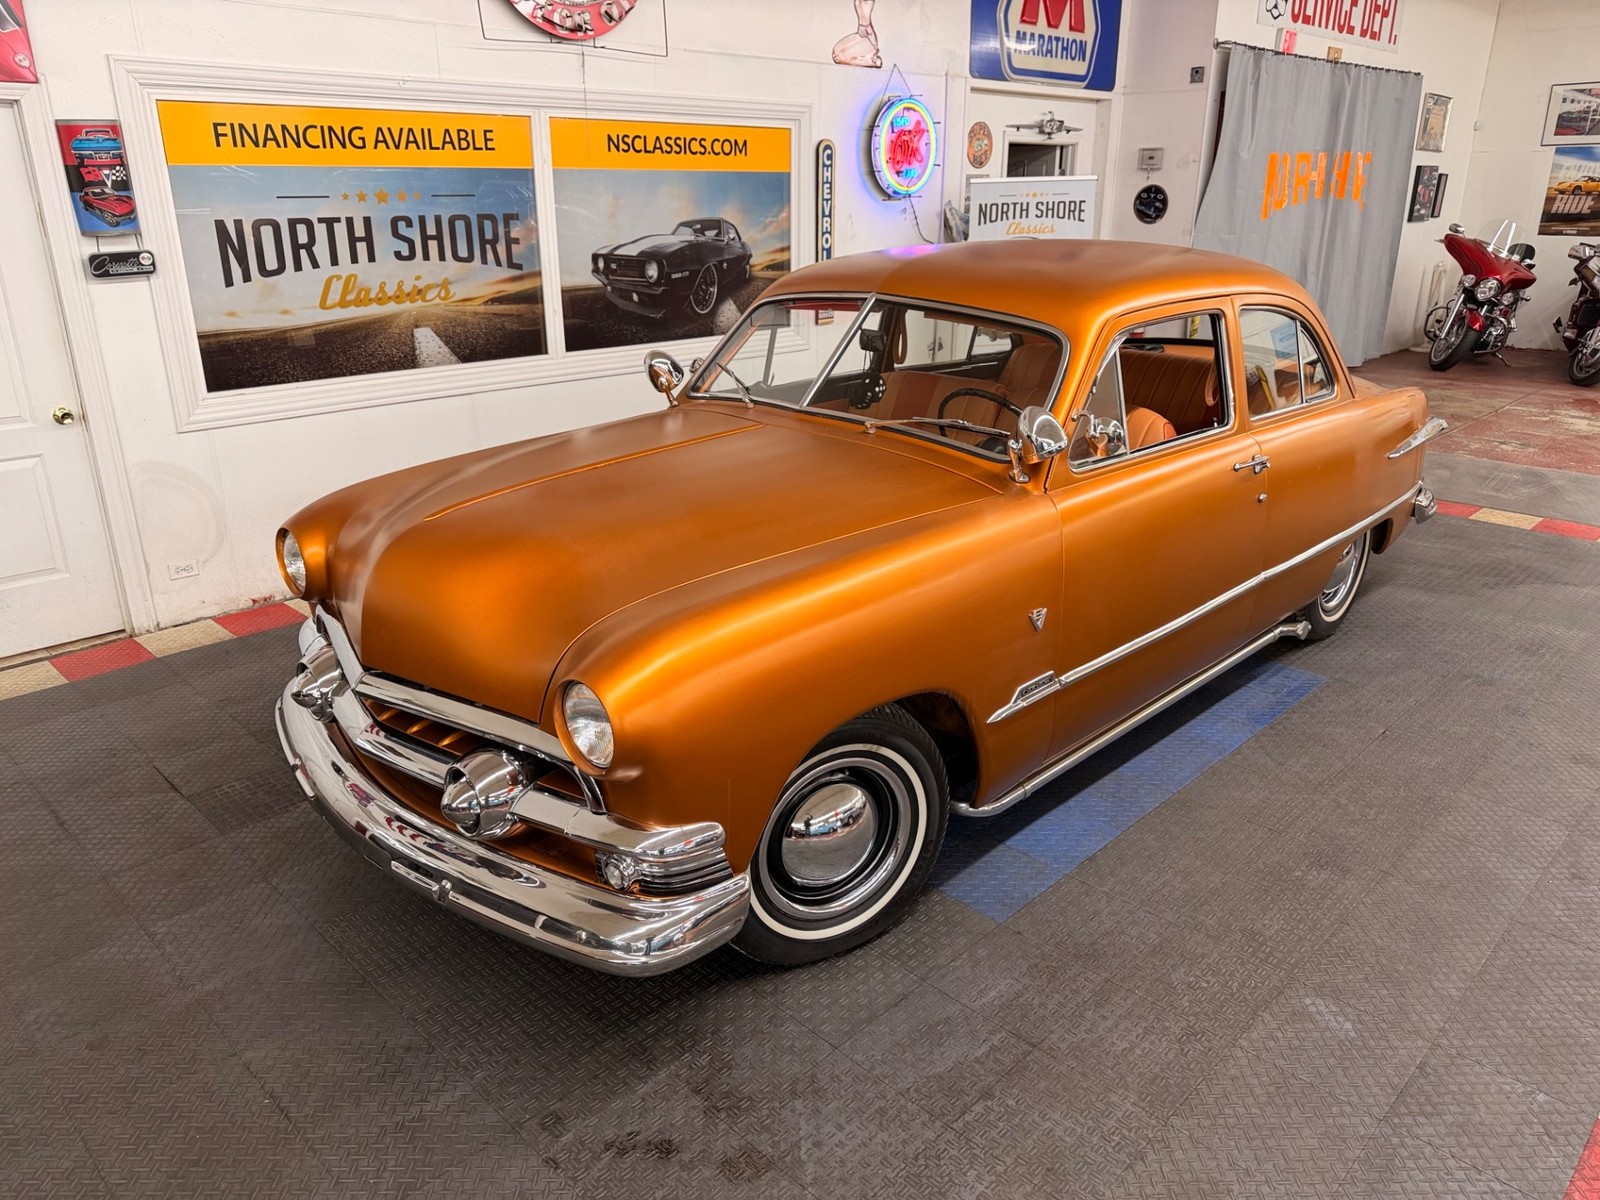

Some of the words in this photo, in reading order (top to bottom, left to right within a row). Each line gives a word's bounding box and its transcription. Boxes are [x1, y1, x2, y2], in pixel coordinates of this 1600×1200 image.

[1014, 30, 1087, 62] MARATHON
[212, 122, 367, 150] FINANCING
[374, 127, 496, 152] AVAILABLE
[607, 133, 748, 157] NSCLASSICS.COM
[1140, 192, 1164, 200] GTO
[1551, 193, 1596, 214] RIDE
[978, 201, 1030, 226] NORTH
[1035, 199, 1087, 223] SHORE
[1006, 222, 1056, 236] Classics
[214, 216, 377, 288] NORTH
[390, 211, 525, 271] SHORE
[91, 256, 141, 274] Corvette
[318, 273, 456, 311] Classics
